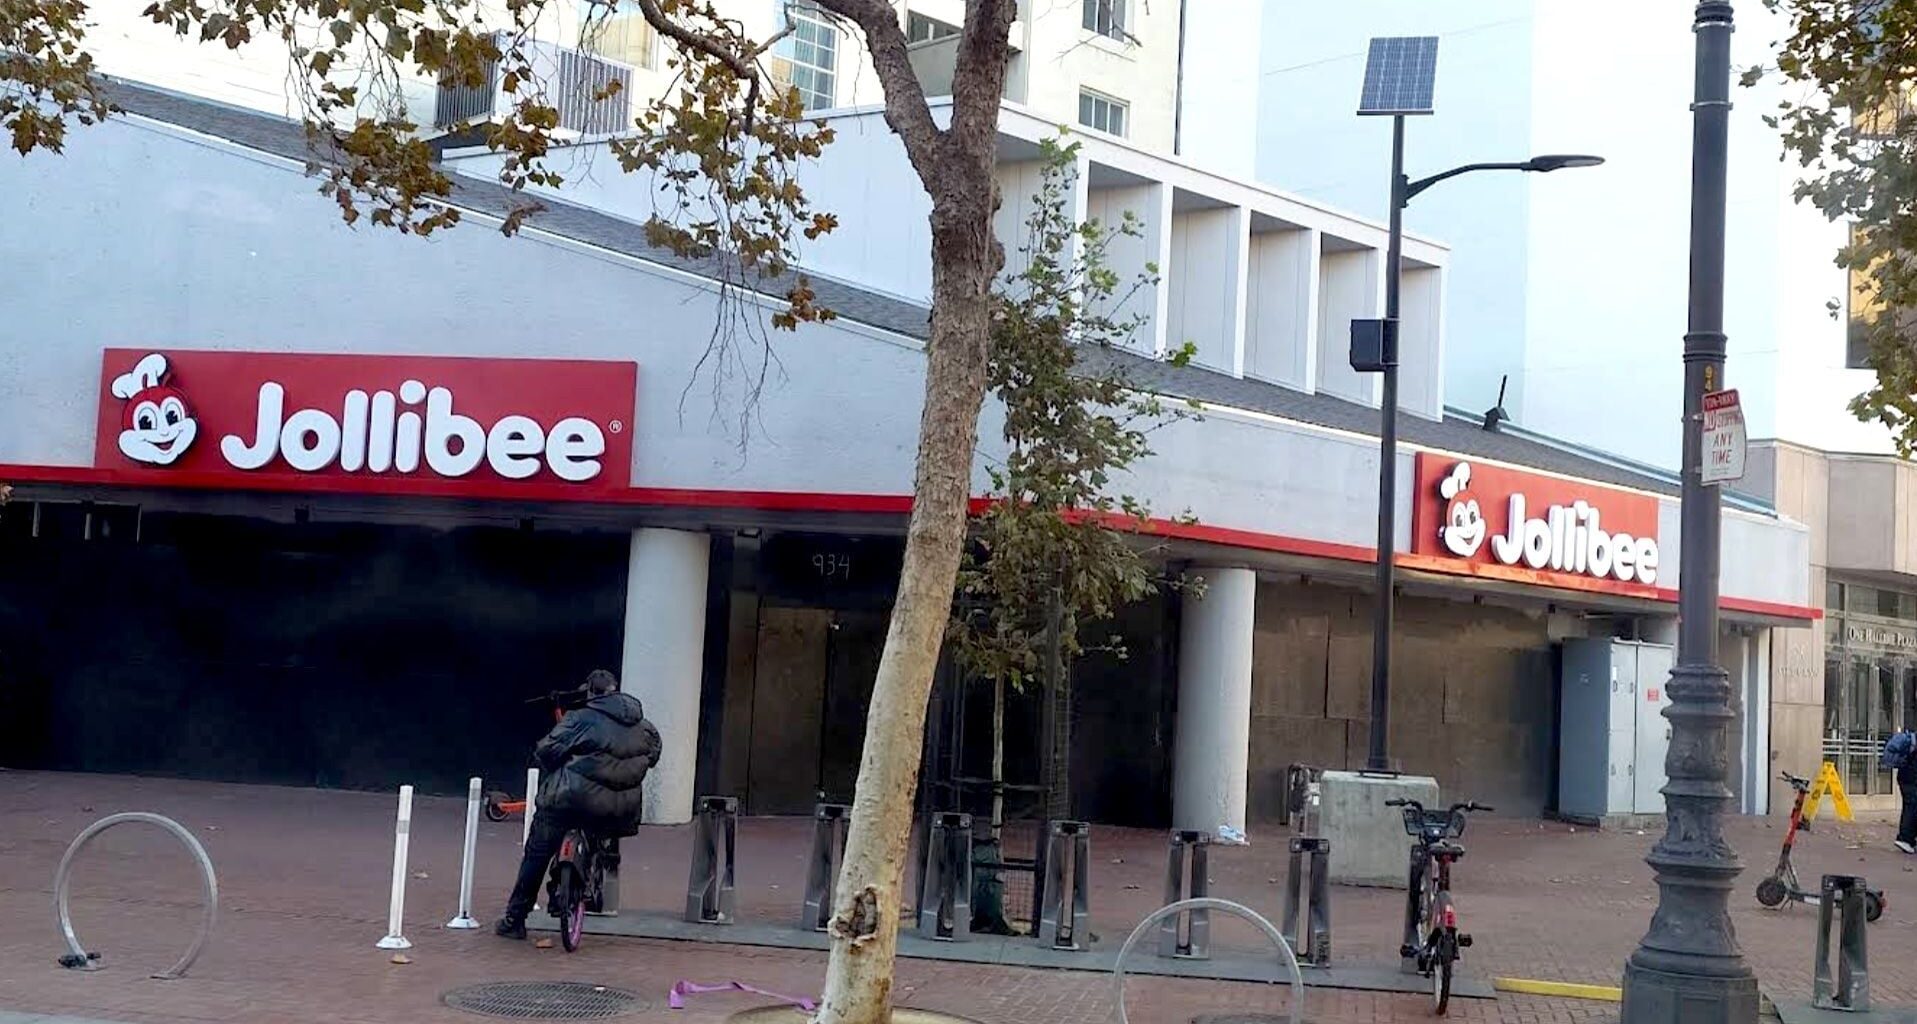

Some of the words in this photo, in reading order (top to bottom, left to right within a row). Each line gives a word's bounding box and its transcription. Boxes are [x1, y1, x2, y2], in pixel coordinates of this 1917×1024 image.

[220, 380, 606, 481] Jollibee
[1713, 432, 1733, 448] ANY
[1712, 449, 1733, 466] TIME
[1491, 493, 1659, 584] Jollibee
[812, 554, 850, 580] 934
